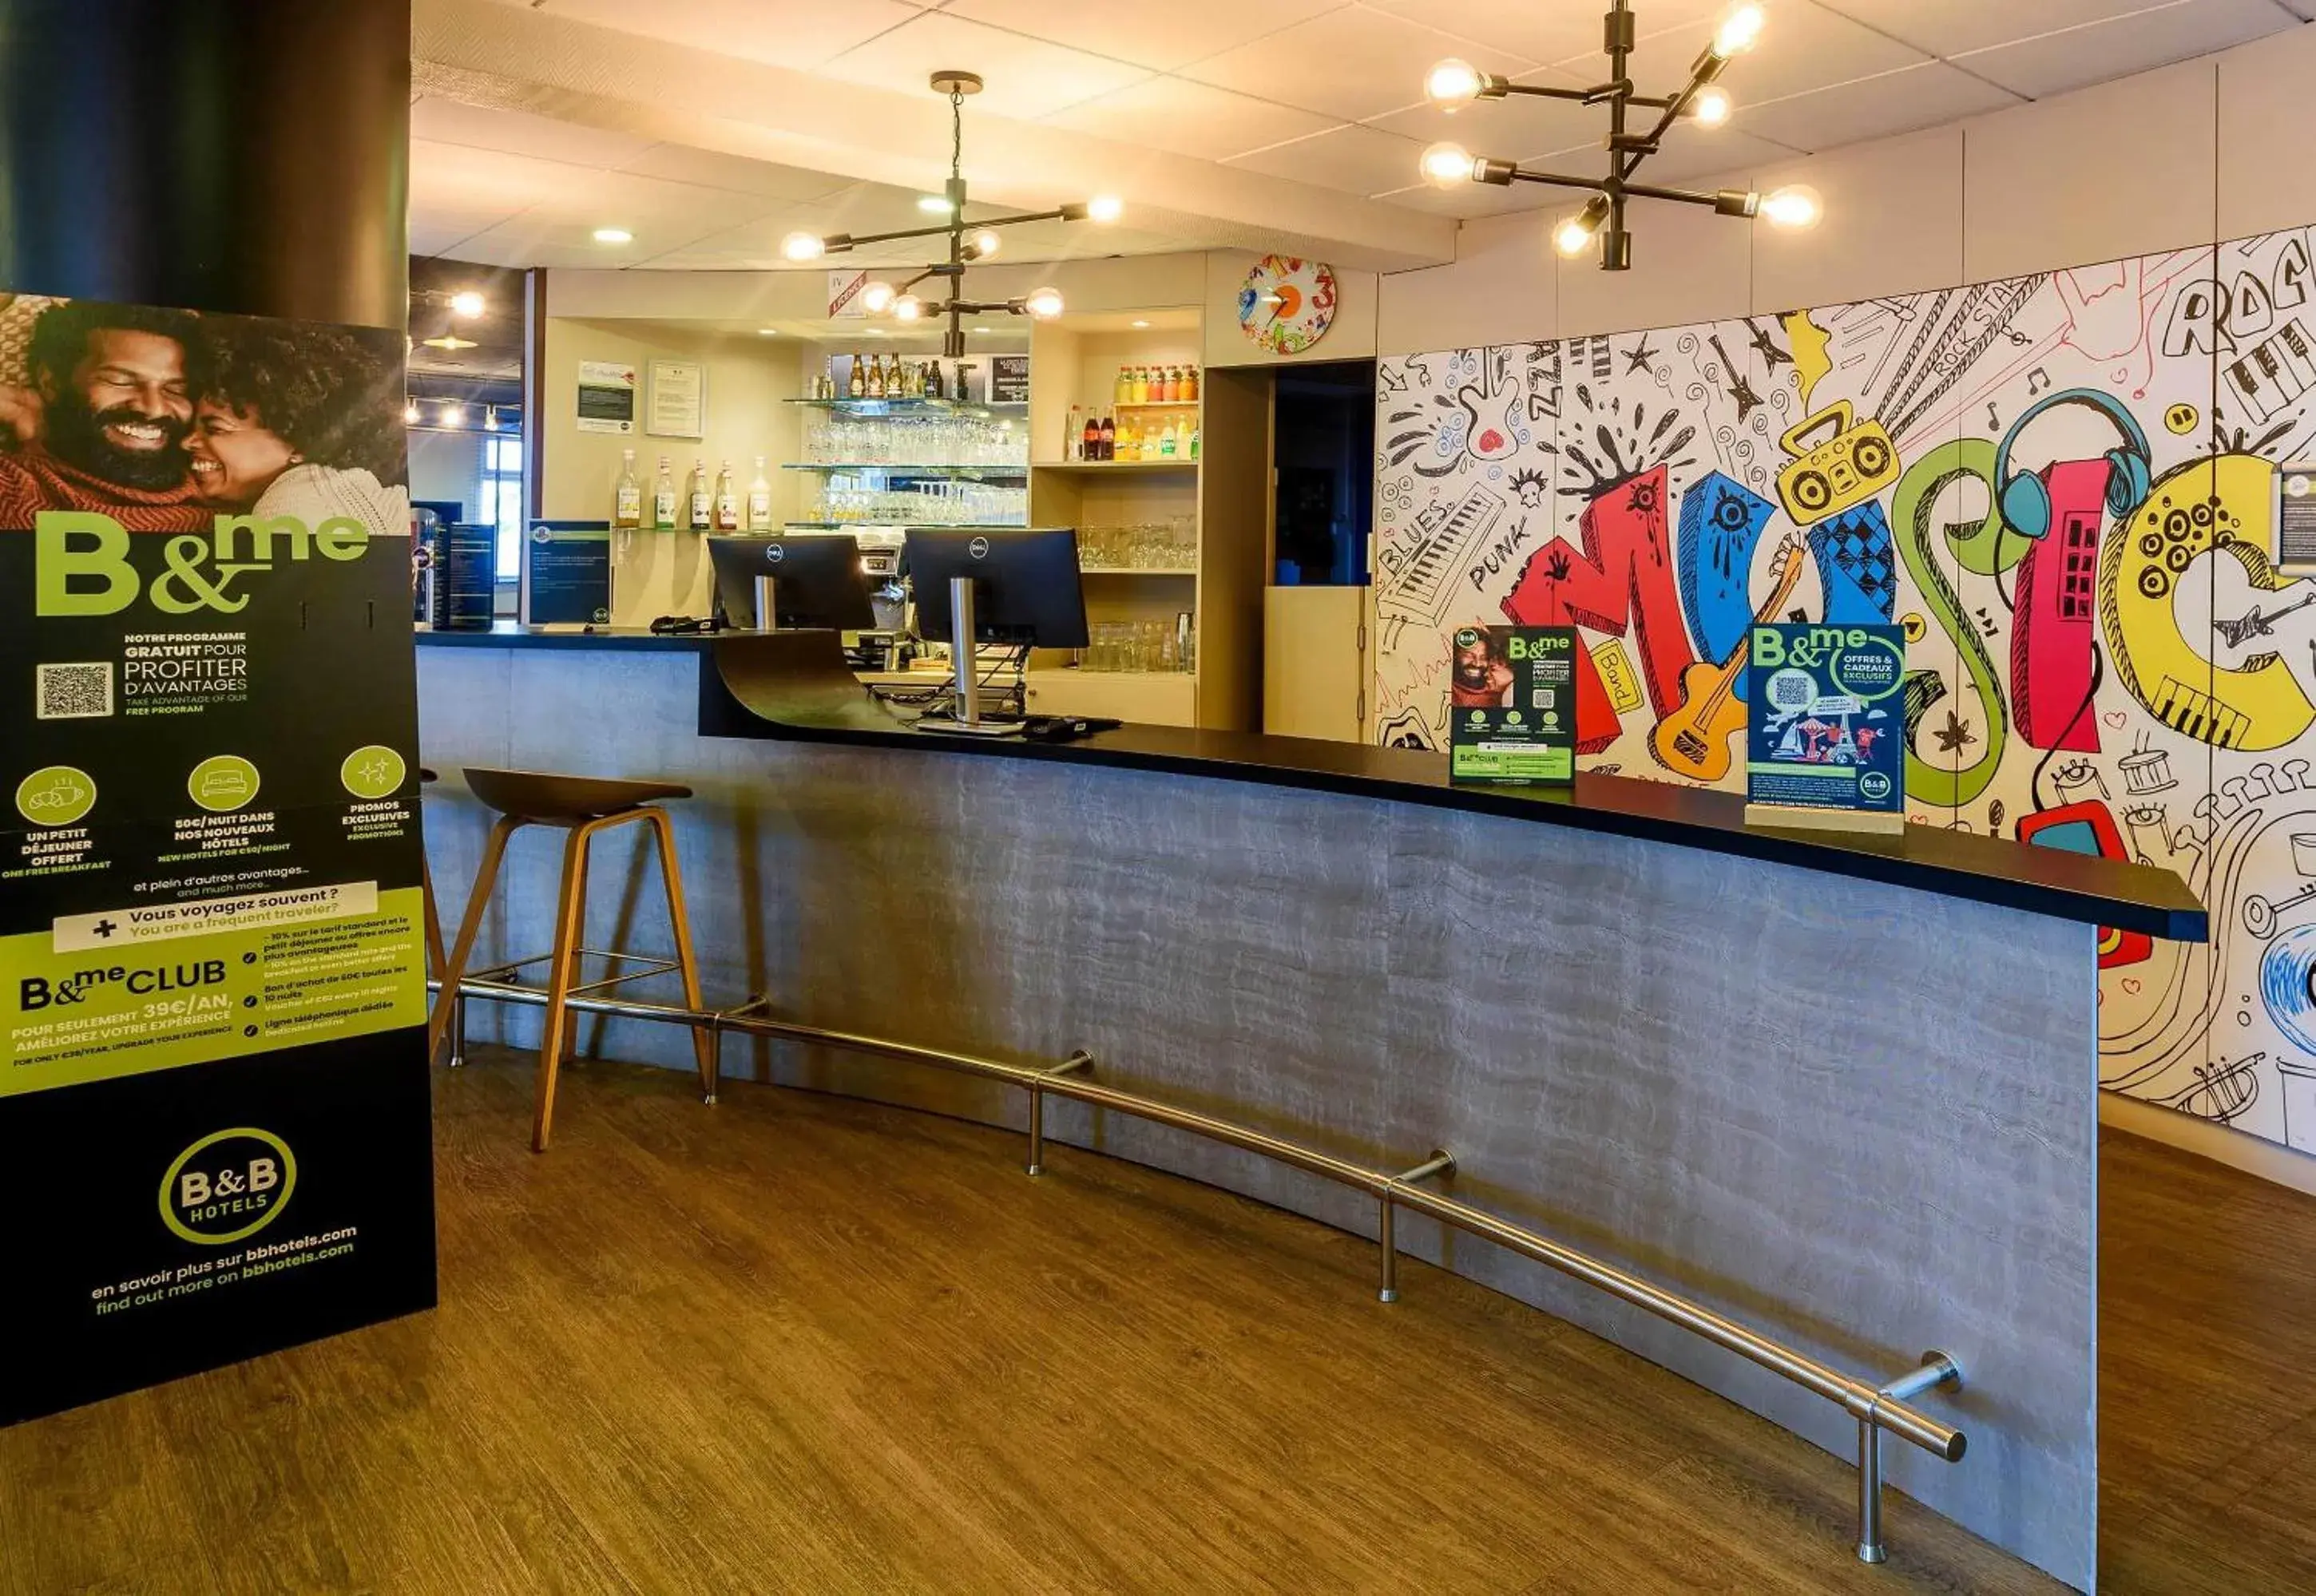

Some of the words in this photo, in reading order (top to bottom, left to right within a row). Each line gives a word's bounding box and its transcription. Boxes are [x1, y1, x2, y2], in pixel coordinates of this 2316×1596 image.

[2162, 227, 2316, 357] ROC
[1933, 330, 1977, 377] ROCK
[1378, 499, 1448, 576] BLUES
[1469, 515, 1530, 592] PUNK
[36, 511, 369, 616] B&me
[125, 634, 166, 643] NOTRE
[168, 632, 246, 642] PROGRAMME
[125, 645, 201, 657] GRATUIT
[204, 644, 246, 655] POUR
[1509, 637, 1569, 659] B&me
[1753, 628, 1867, 667] B&me
[1843, 655, 1882, 663] OFFRES
[1883, 655, 1892, 664] &
[125, 659, 246, 679] PROFITER
[1600, 652, 1631, 699] Band
[125, 679, 248, 695] D'AVANTAGES
[153, 695, 210, 705] ADVANTAGE
[227, 694, 248, 703] OUR
[152, 705, 204, 714] PROGRAM
[350, 801, 399, 813] PROMOS
[240, 812, 275, 823] DANS
[342, 811, 410, 825] EXCLUSIVES
[26, 832, 47, 842] UN
[50, 828, 88, 840] PETIT
[174, 830, 202, 841] NOS
[204, 823, 275, 838] NOUVEAUX
[353, 822, 398, 832] EXCLUSIVE
[202, 837, 249, 849] HÔTELS
[31, 853, 83, 866] OFFERT
[158, 853, 181, 862] NEW
[182, 850, 217, 861] HOTELS
[219, 848, 237, 857] FOR
[2, 869, 24, 878] ONE
[26, 867, 50, 876] FREE
[52, 861, 111, 873] BREAKFAST
[133, 881, 147, 892] et
[150, 879, 181, 893] plein
[184, 873, 235, 886] d'autres
[176, 887, 200, 897] and
[201, 884, 234, 896] much
[129, 908, 176, 923] Vous
[180, 900, 255, 918] voyagez
[259, 889, 326, 908] souvent
[330, 888, 339, 899] ?
[129, 926, 160, 937] You
[164, 921, 190, 933] are
[193, 921, 204, 929] a
[206, 911, 271, 929] frequent
[321, 925, 340, 935] tarif
[343, 920, 387, 932] standard
[264, 942, 288, 953] petit
[264, 984, 284, 994] Bon
[11, 1024, 53, 1040] POUR
[56, 1011, 138, 1032] SEULEMENT
[14, 1032, 97, 1053] AMÉLIOREZ
[101, 1022, 148, 1039] VOTRE
[150, 1010, 232, 1032] EXPÉRIENCE
[13, 1058, 33, 1067] FOR
[34, 1054, 60, 1064] ONLY
[113, 1038, 154, 1051] UPGRADE
[156, 1033, 180, 1044] YOUR
[183, 1026, 232, 1040] EXPERIENCE
[181, 1158, 279, 1208] B&B
[191, 1194, 268, 1222] HOTELS
[91, 1284, 115, 1300] en
[119, 1271, 173, 1293] savoir
[176, 1260, 213, 1283] plus
[216, 1253, 243, 1269] sur
[246, 1226, 357, 1262] bbhotels.com
[97, 1297, 130, 1316] find
[135, 1289, 165, 1306] out
[168, 1278, 213, 1298] more
[217, 1270, 239, 1285] on
[243, 1242, 355, 1279] bbhotels.com
